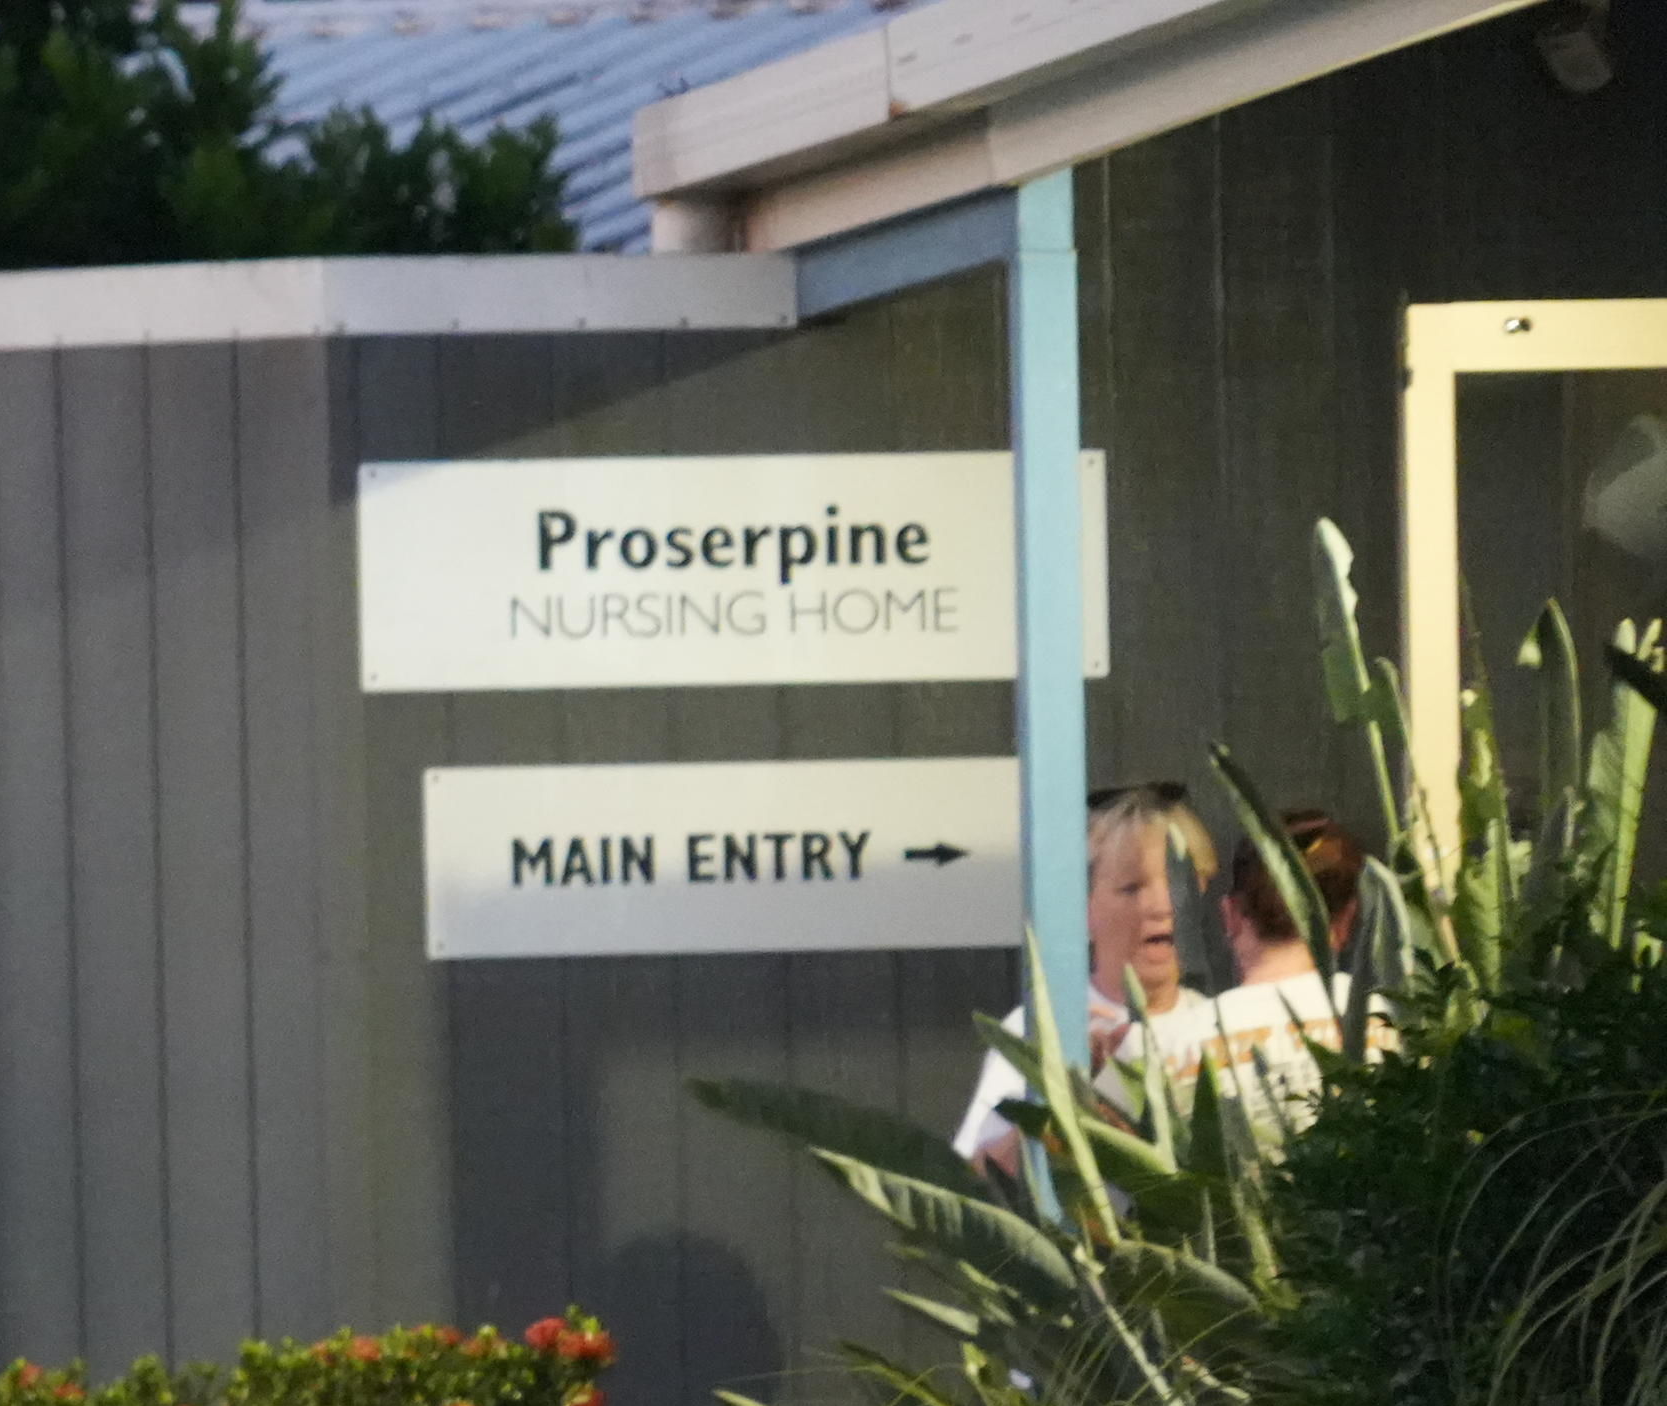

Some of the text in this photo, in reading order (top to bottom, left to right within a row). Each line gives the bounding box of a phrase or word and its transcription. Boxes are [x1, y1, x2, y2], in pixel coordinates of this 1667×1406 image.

[537, 504, 931, 586] Proserpine
[508, 585, 961, 639] NURSING HOME
[512, 831, 872, 887] MAIN ENTRY
